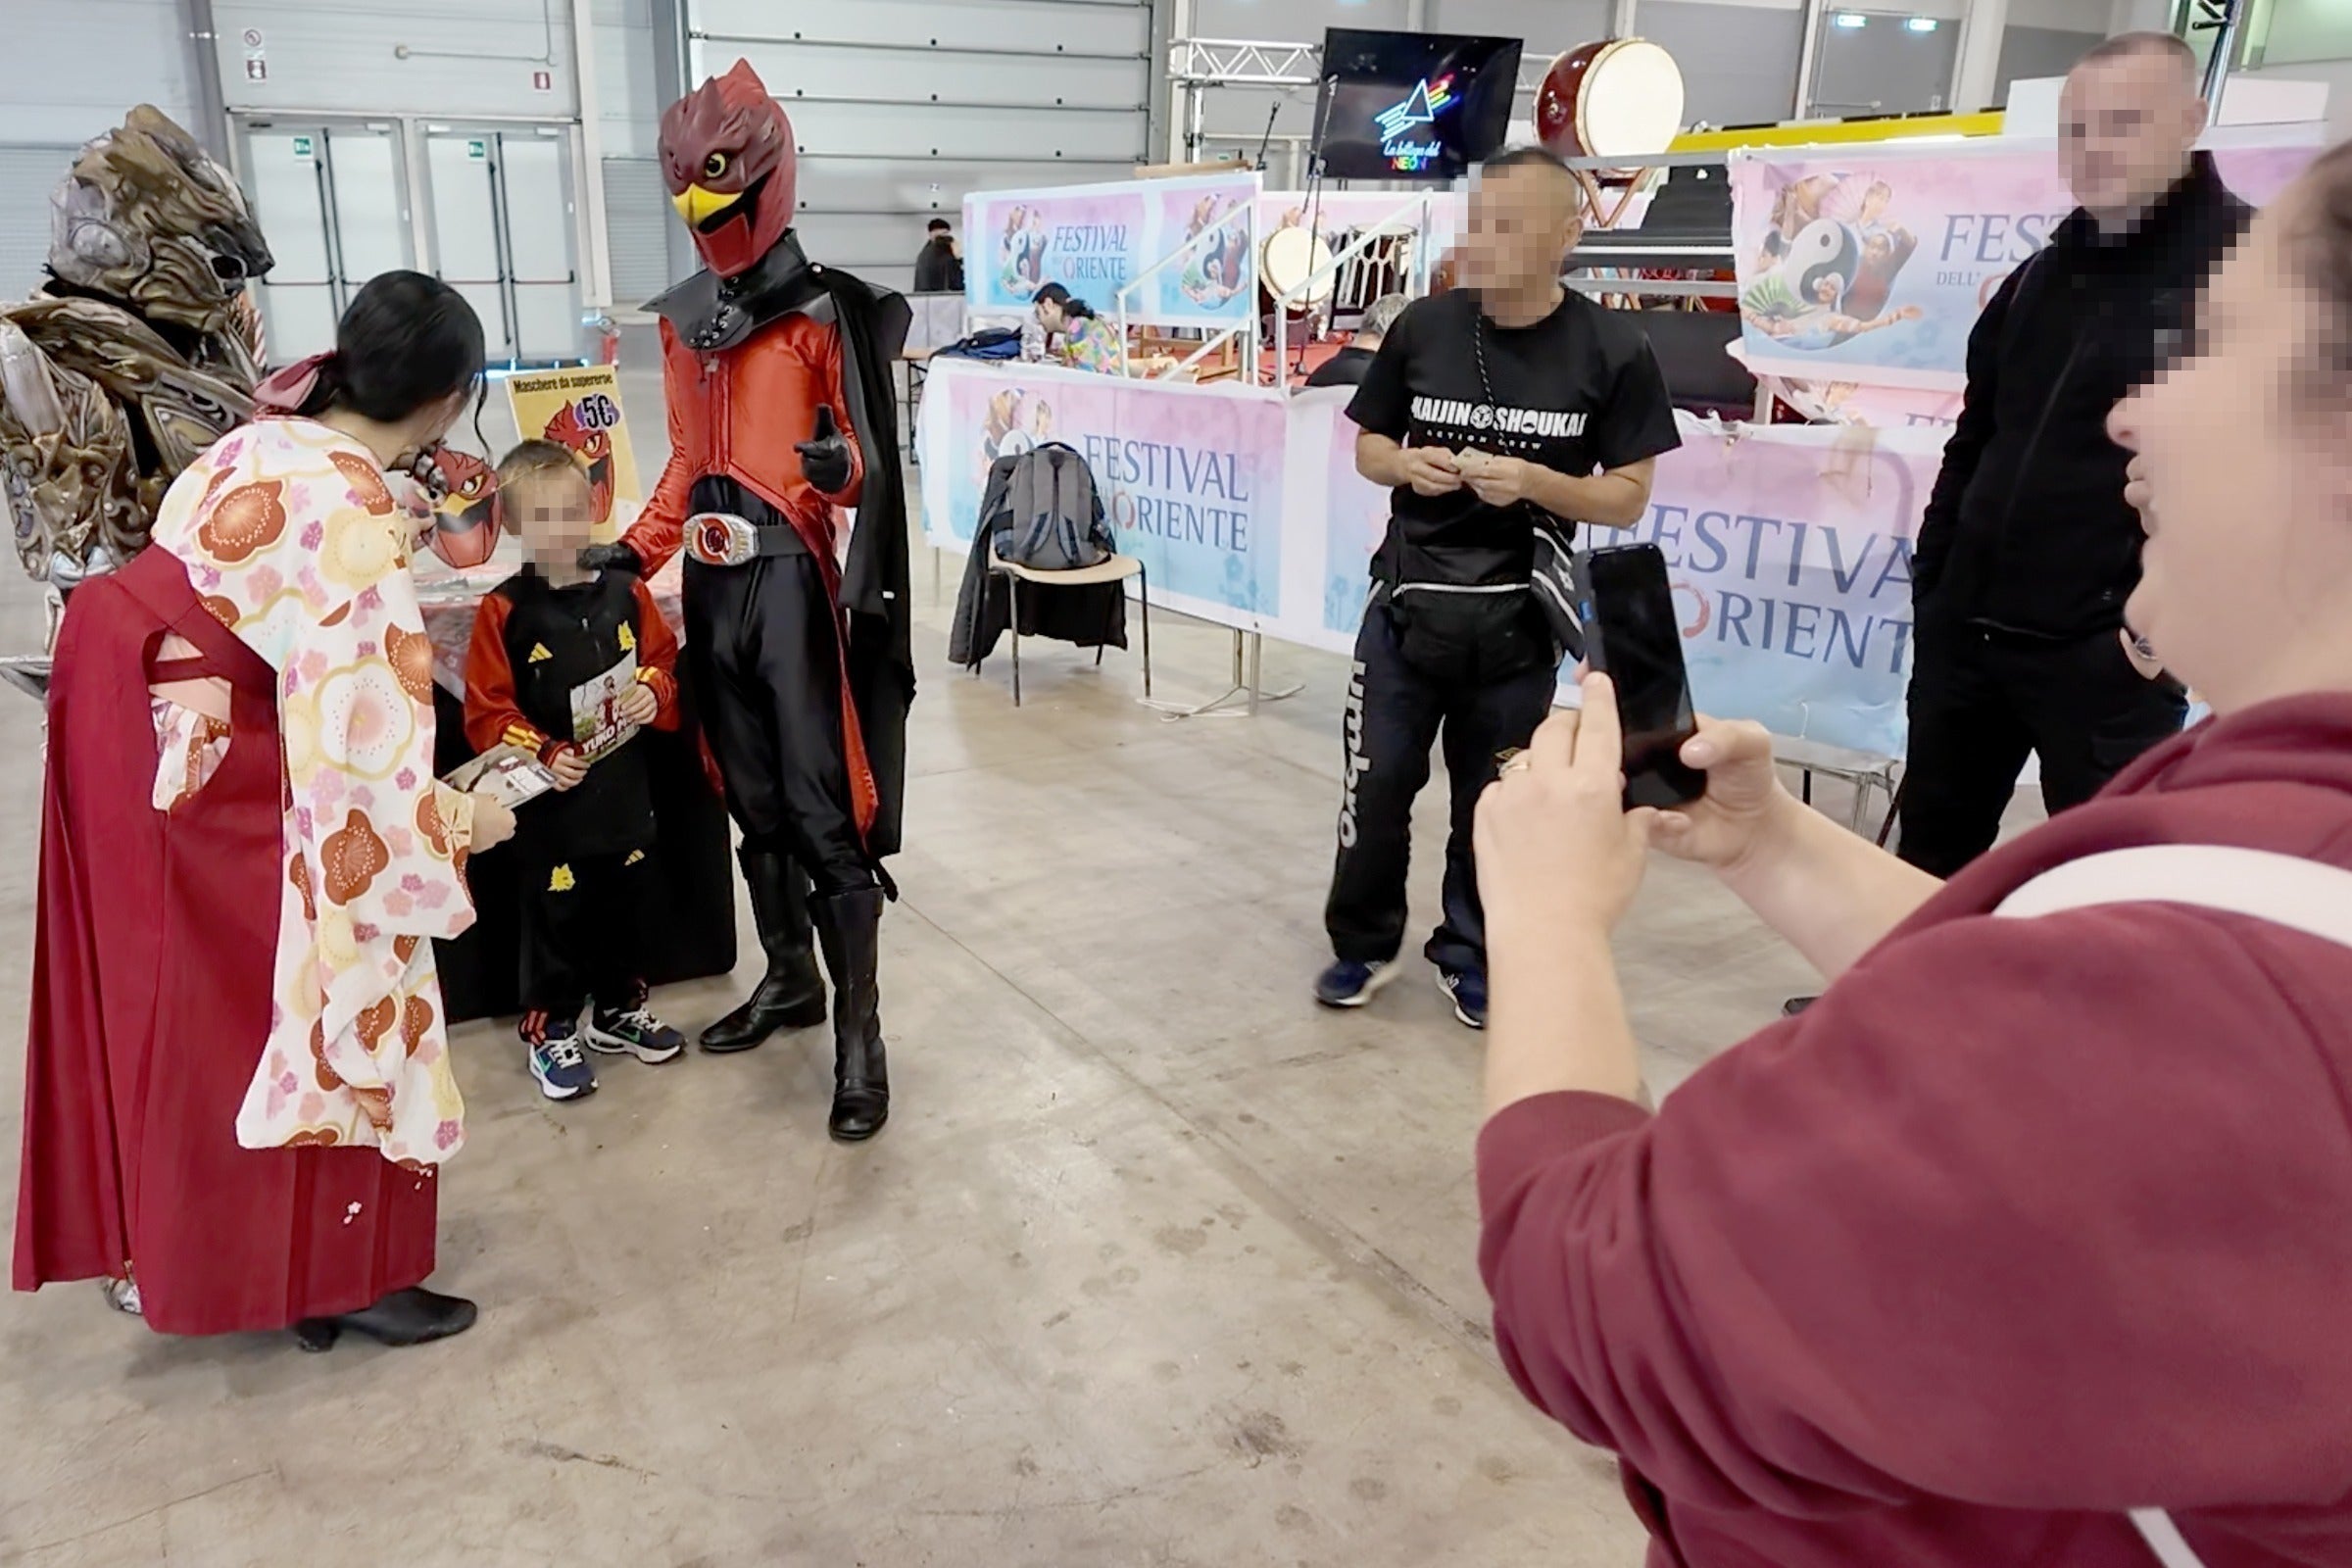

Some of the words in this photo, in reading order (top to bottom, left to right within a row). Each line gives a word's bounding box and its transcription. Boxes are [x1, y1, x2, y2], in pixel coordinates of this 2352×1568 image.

[1391, 156, 1428, 170] NEON
[1053, 224, 1128, 252] FESTIVAL
[1940, 213, 2069, 263] FES
[1063, 256, 1127, 280] ORIENTE
[559, 376, 569, 388] da
[1410, 395, 1472, 426] KAIJIN
[1084, 434, 1249, 503] FESTIVAL
[1112, 491, 1249, 553] ORIENTE
